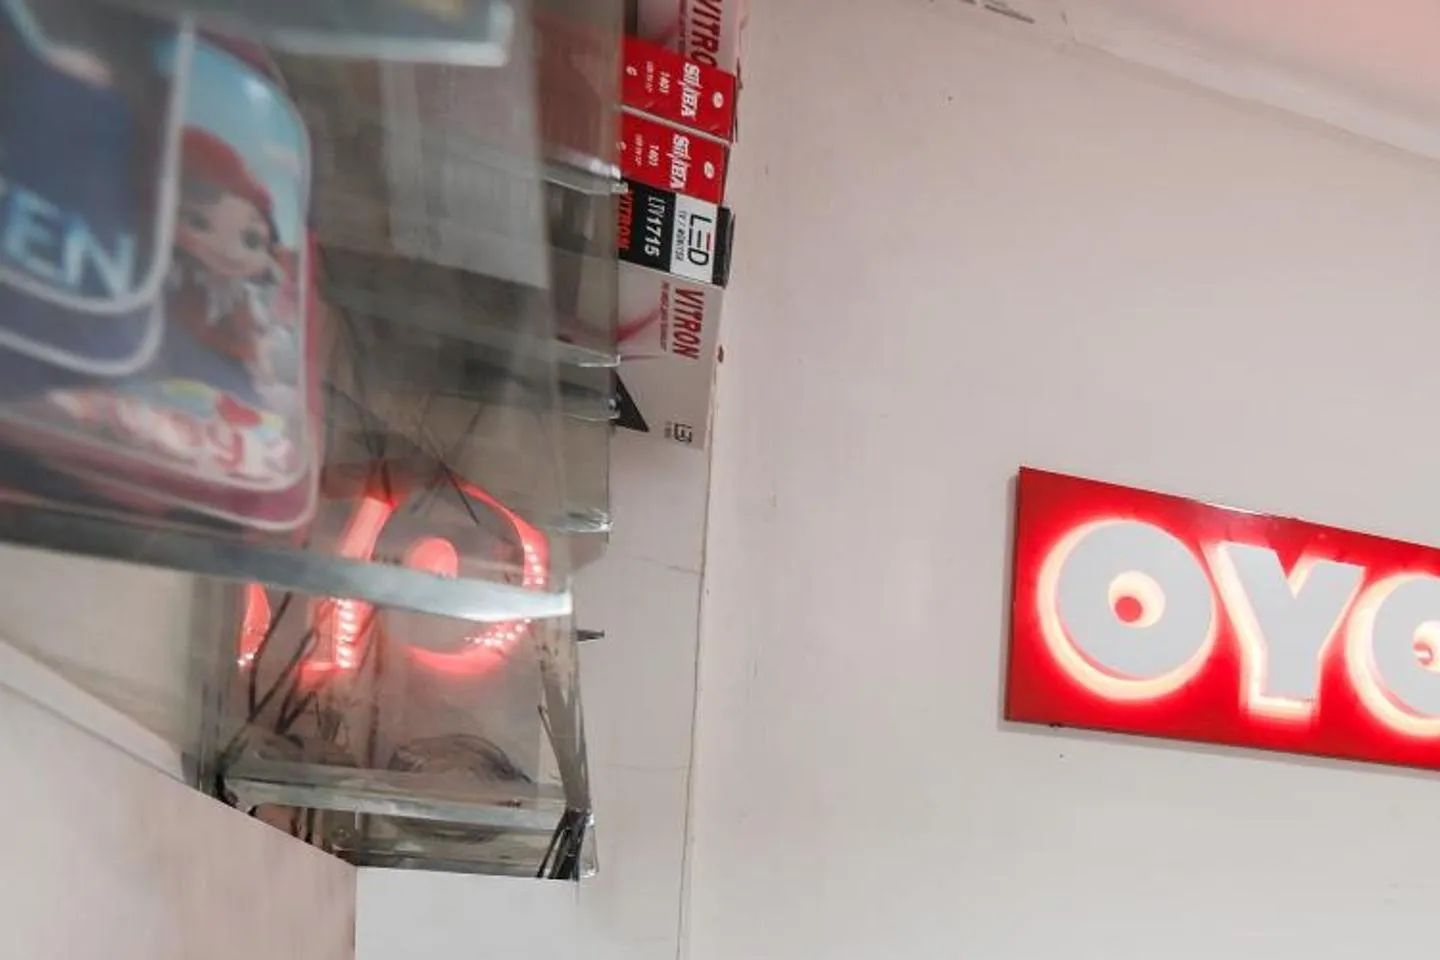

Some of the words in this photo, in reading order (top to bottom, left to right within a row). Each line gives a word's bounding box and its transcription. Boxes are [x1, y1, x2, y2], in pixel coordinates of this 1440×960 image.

[690, 0, 721, 67] VITRO
[687, 213, 713, 266] LED
[672, 287, 705, 360] VITRON
